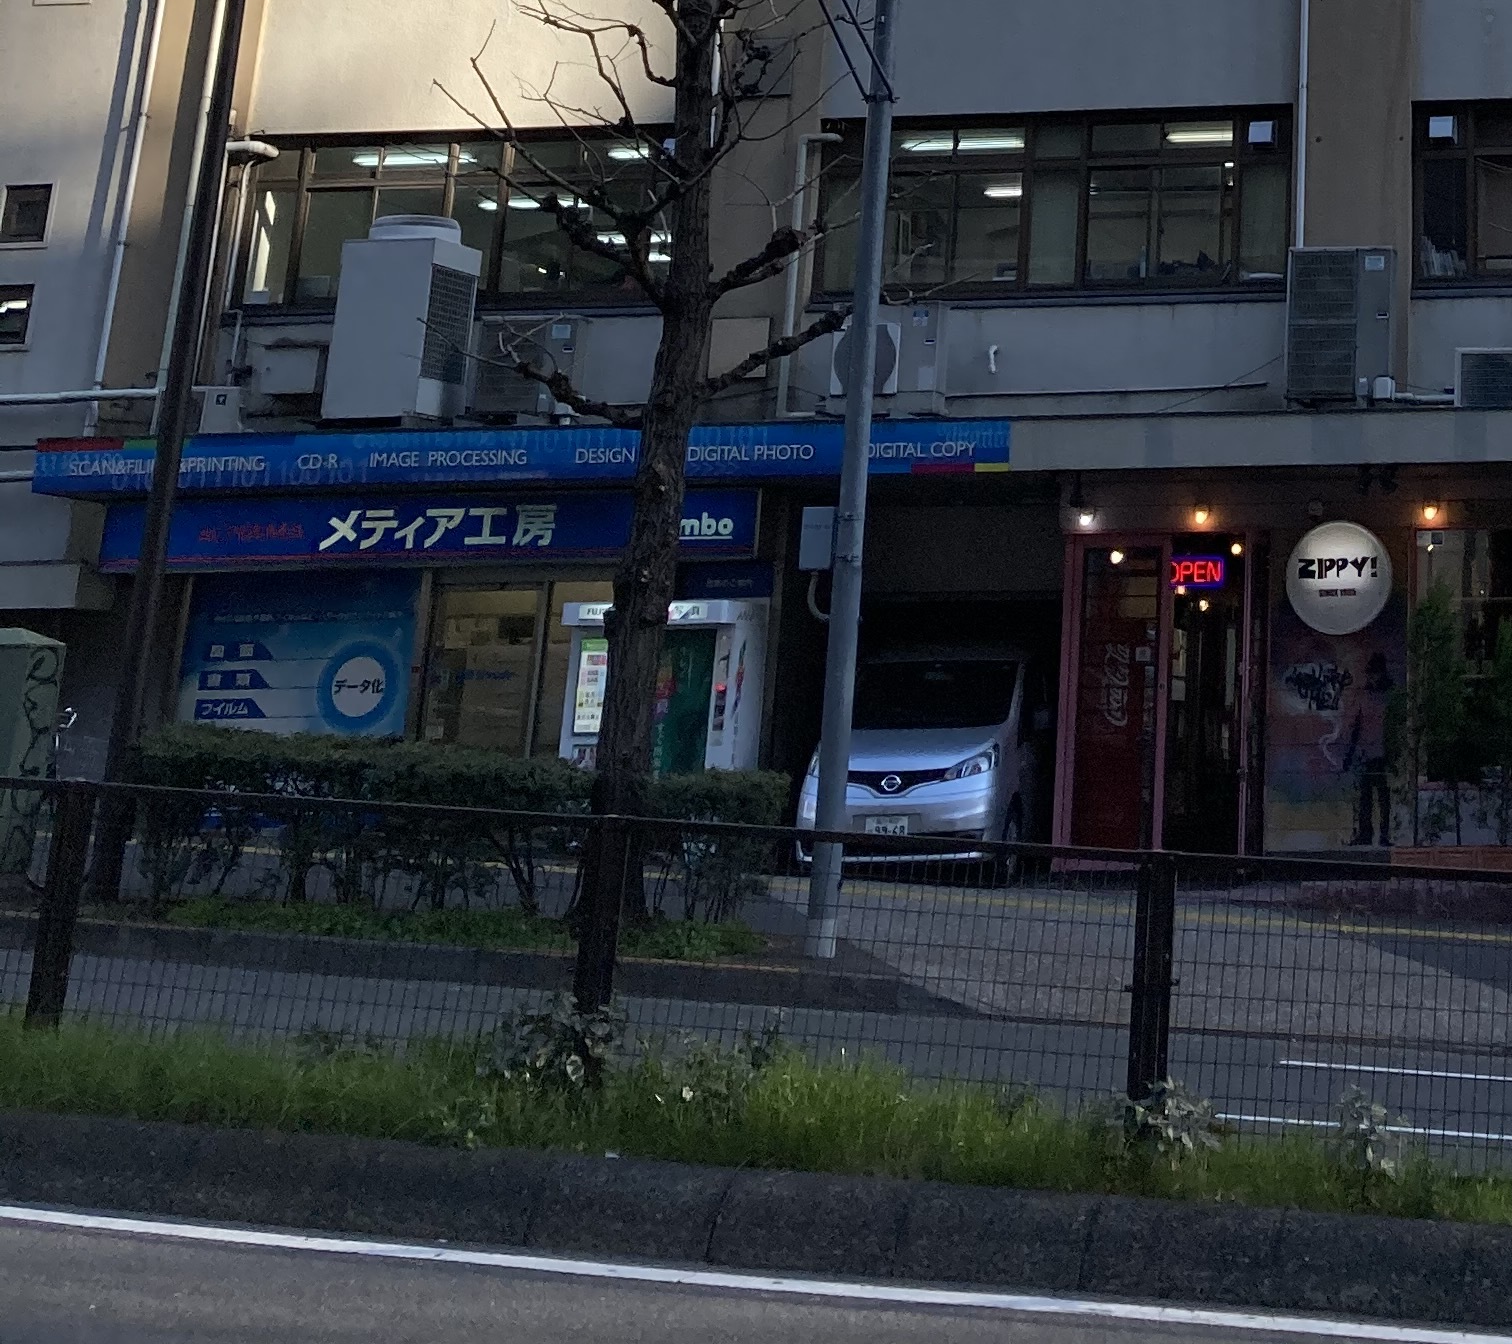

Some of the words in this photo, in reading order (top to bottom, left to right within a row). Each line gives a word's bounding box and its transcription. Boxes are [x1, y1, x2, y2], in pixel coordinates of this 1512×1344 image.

[369, 451, 420, 468] IMAGE
[427, 448, 528, 467] PROCESSING
[575, 446, 636, 464] DESIGN
[686, 445, 750, 462] DIGITAL
[753, 443, 814, 460] PHOTO
[868, 442, 927, 458] DIGITAL
[930, 441, 977, 458] COPY
[1298, 556, 1378, 580] ZIPPY!
[333, 678, 384, 695] データ化
